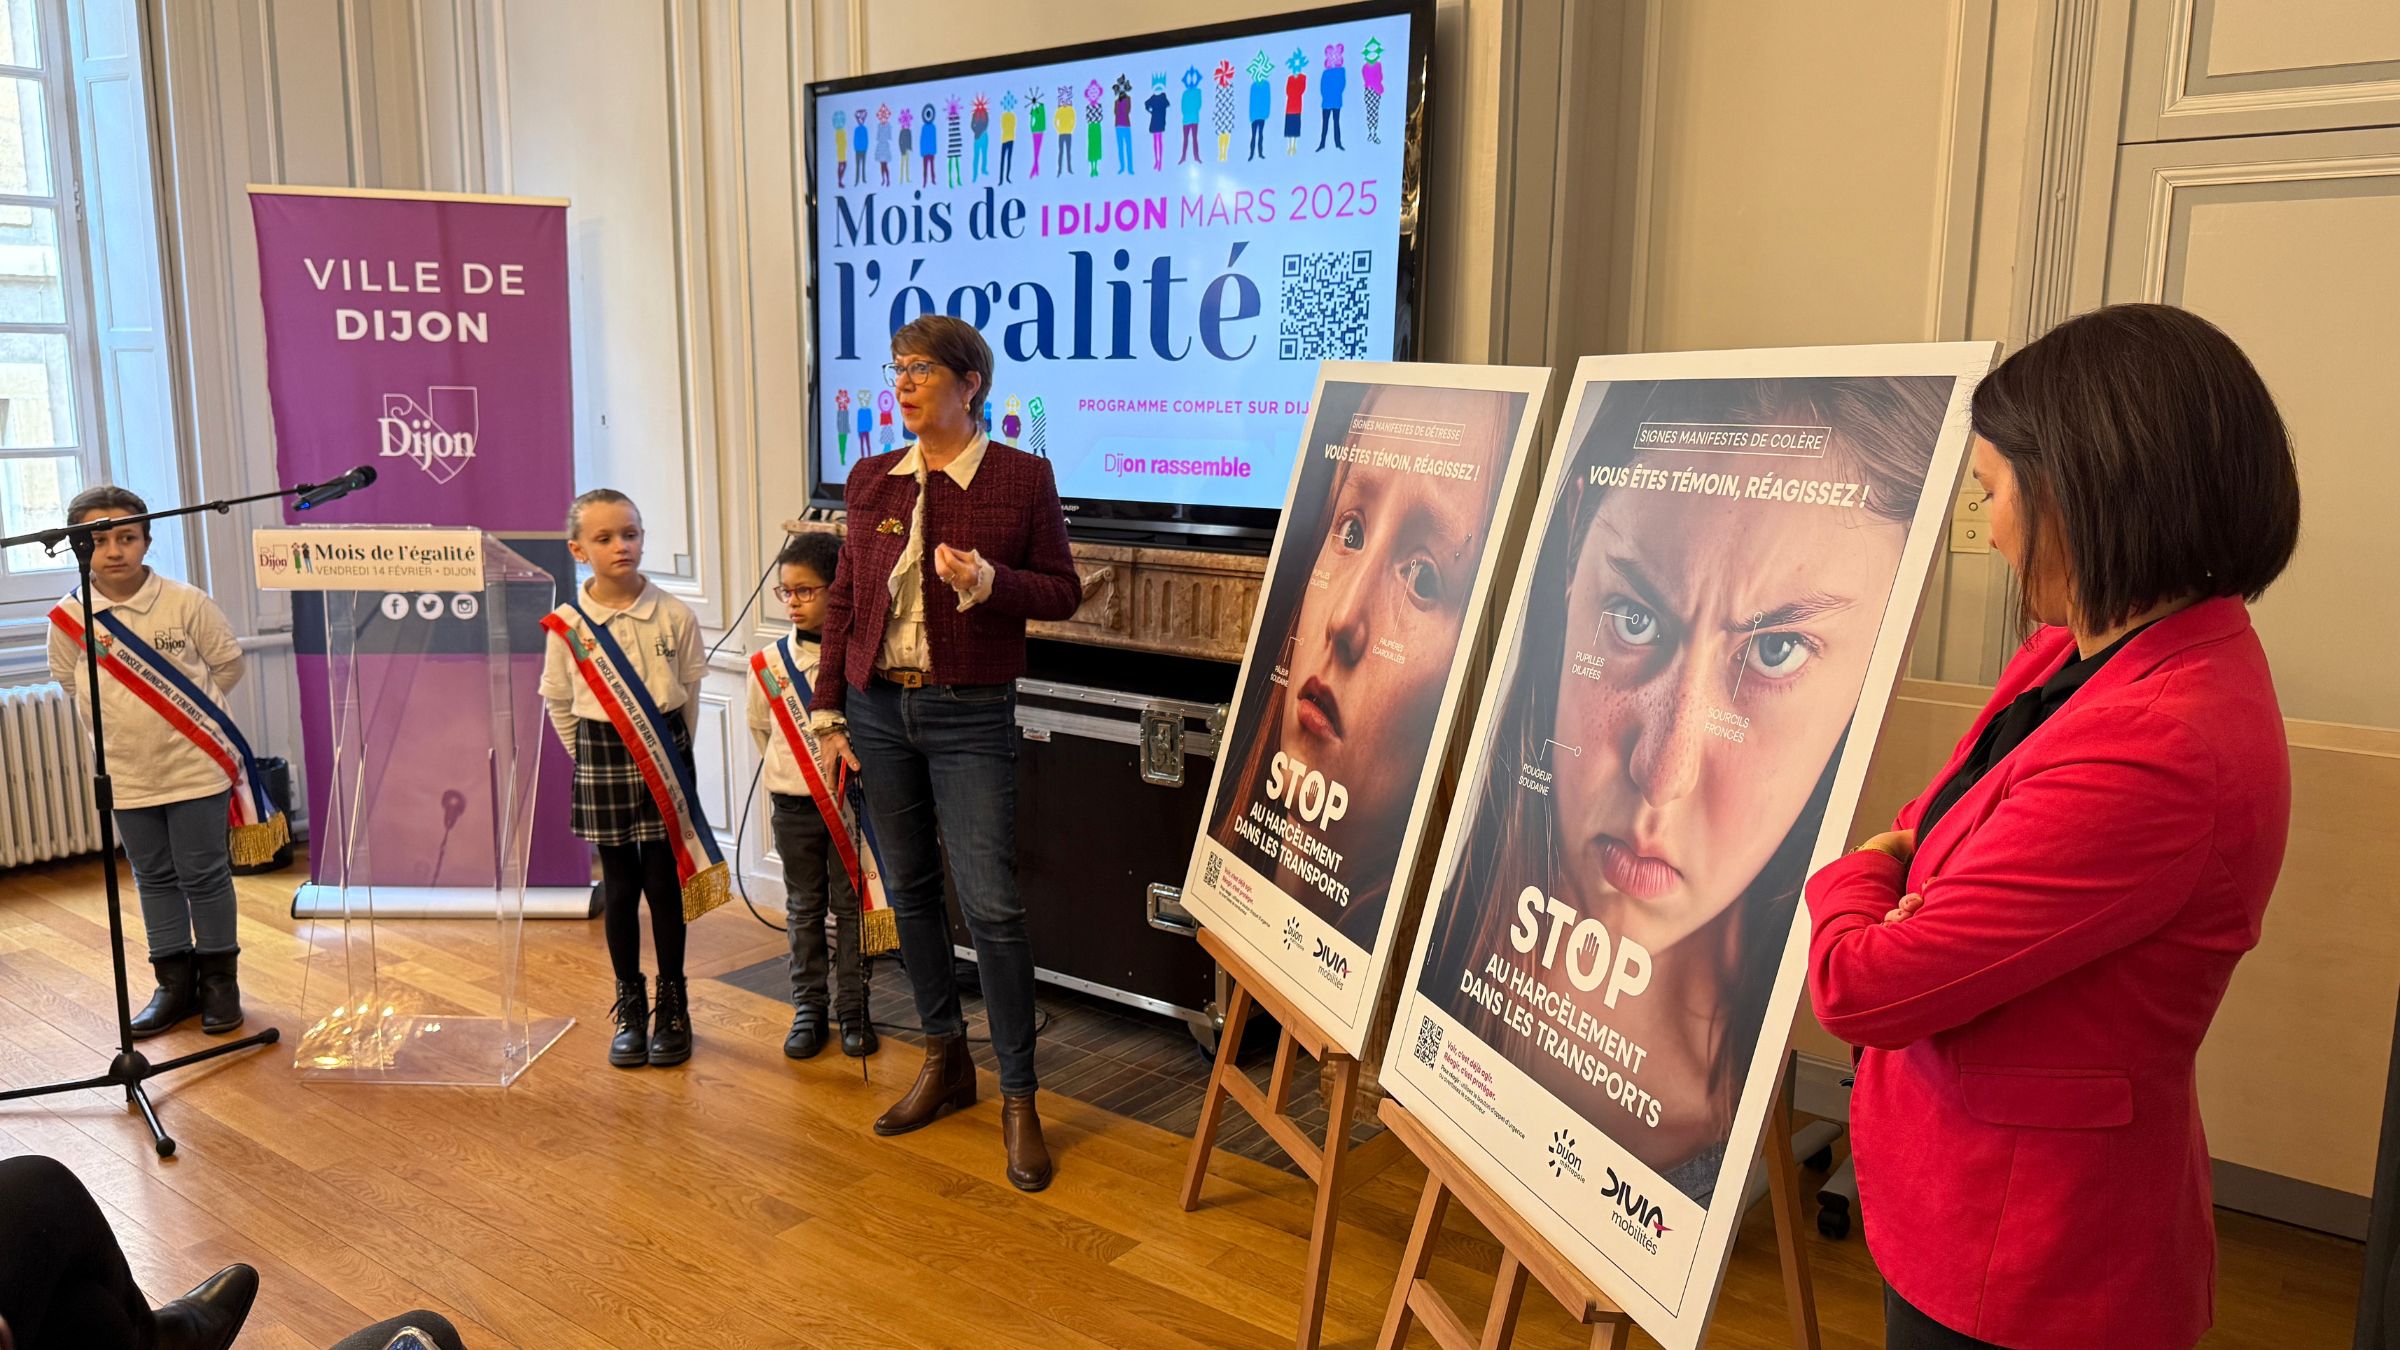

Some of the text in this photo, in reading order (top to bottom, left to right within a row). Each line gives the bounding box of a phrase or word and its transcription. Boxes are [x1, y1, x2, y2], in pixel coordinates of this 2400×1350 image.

[834, 187, 1026, 248] Mois de
[1058, 197, 1167, 235] DIJON
[1180, 188, 1276, 228] MARS
[1289, 179, 1377, 221] 2025
[304, 258, 525, 295] VILLE DE
[336, 309, 488, 343] DIJON
[1079, 399, 1310, 415] PROGRAMME COMPLET SUR DIJ
[1352, 418, 1461, 441] SIGNES MANIFESTES DE DÉTRESSE
[1639, 429, 1823, 450] SIGNES MANIFESTES DE COLÈRE
[378, 418, 476, 471] Dijon
[1324, 443, 1350, 462] VOUS
[1349, 444, 1370, 465] ÊTES
[1372, 448, 1412, 474] TÉMOIN,
[1104, 453, 1251, 478] Dijon rassemble
[1589, 465, 1630, 487] VOUS
[1629, 463, 1667, 491] ÊTES
[1671, 466, 1742, 501] TÉMOIN,
[1745, 471, 1859, 508] RÉAGISSEZ
[260, 553, 288, 571] Dijon
[315, 544, 476, 565] Mois de l'égalité
[315, 563, 476, 577] VENDREDI 14 FÉVRIER DIJON
[154, 637, 185, 653] Dijon
[1575, 651, 1605, 667] PUPILLES
[116, 649, 143, 672] CONSEIL
[140, 669, 174, 697] MUNICIPAL
[1571, 664, 1601, 680] DILATÉES
[595, 656, 657, 749] CONSEIL MUNICIPAL D'ENFANTS
[786, 696, 802, 724] CONSEIL
[1703, 722, 1745, 743] FRONCÉS
[1706, 707, 1750, 729] SOURCILS
[1518, 776, 1550, 797] SOUDAINE
[1523, 763, 1553, 784] ROUGEUR
[1266, 751, 1349, 832] STOP
[1249, 801, 1343, 873] AU HARCÈLEMENT
[1233, 815, 1261, 846] DANS
[1259, 832, 1279, 859] LES
[1278, 844, 1350, 907] TRANSPORTS
[1510, 885, 1652, 1010] STOP
[1317, 965, 1344, 990] mobilités
[1485, 953, 1647, 1074] AU HARCÈLEMENT
[1460, 968, 1662, 1128] DANS LES TRANSPORTS
[1611, 1210, 1658, 1256] mobilités
